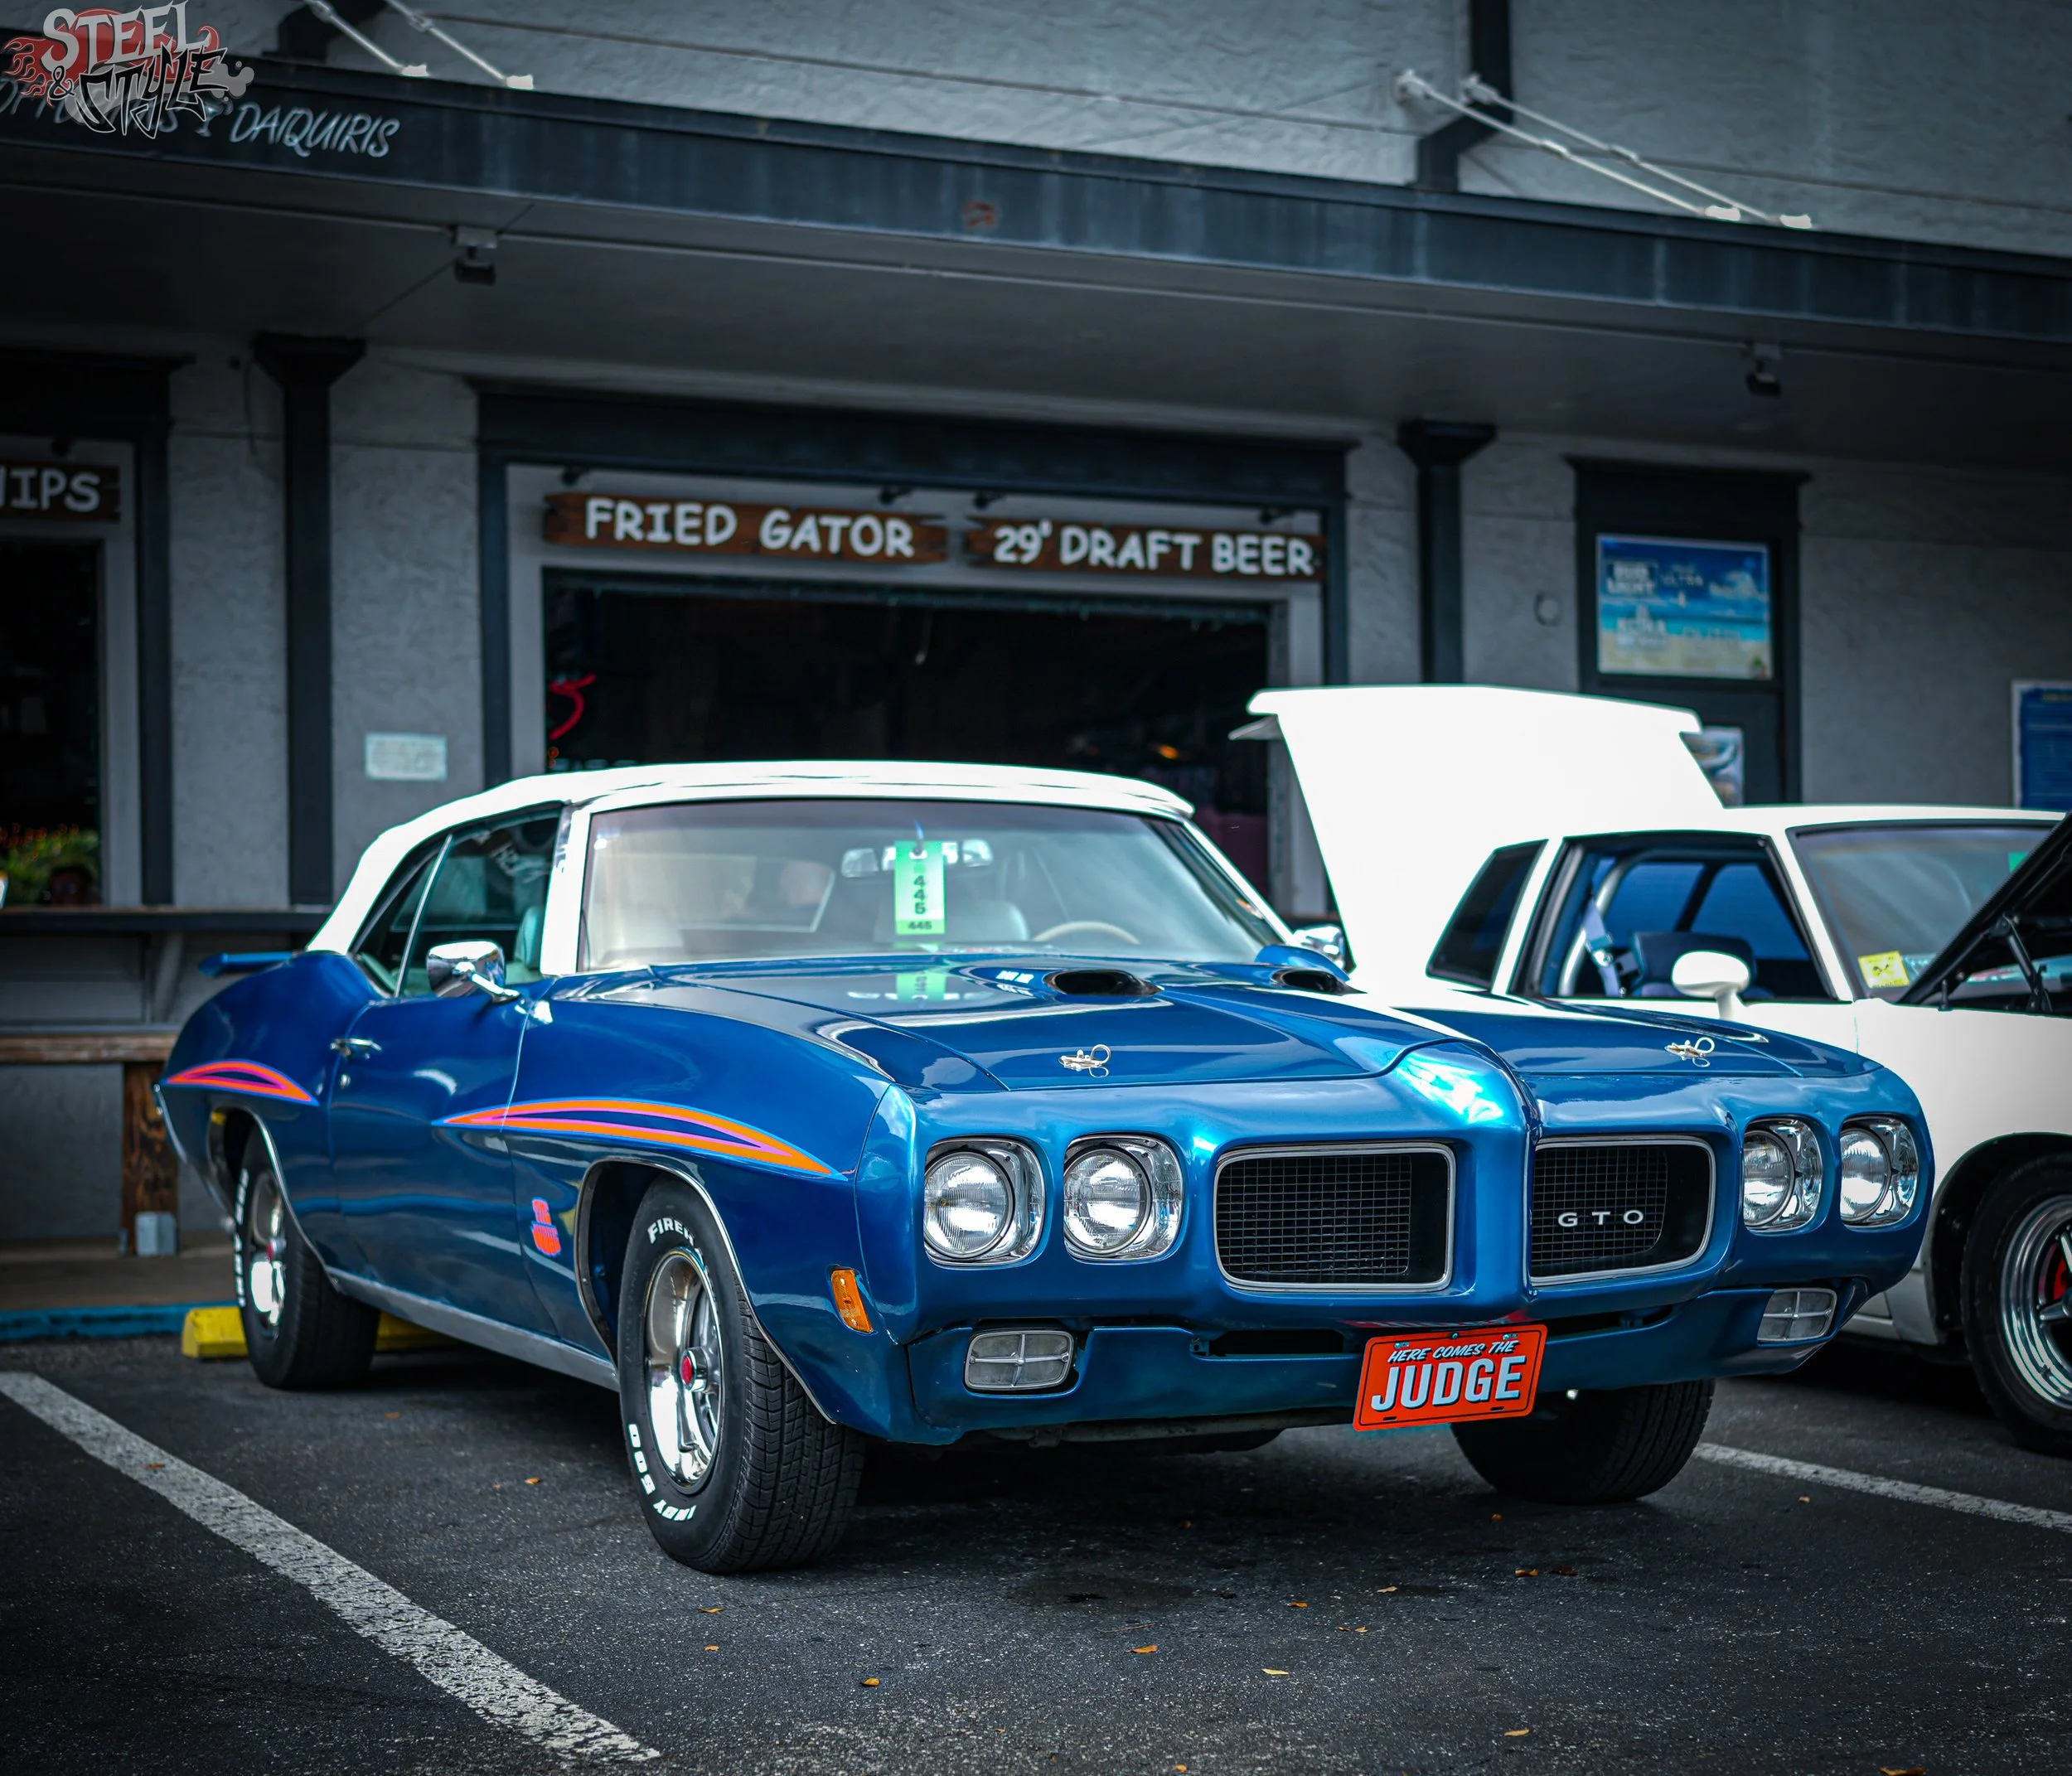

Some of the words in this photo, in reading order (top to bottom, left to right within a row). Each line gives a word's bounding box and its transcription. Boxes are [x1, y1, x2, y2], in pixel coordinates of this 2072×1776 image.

[230, 101, 401, 158] DAIQUIRIS
[0, 467, 100, 512] IPS
[585, 497, 738, 545] FRIED
[759, 508, 916, 558] GATOR
[1059, 525, 1203, 571] DRAFT
[1211, 534, 1315, 577] BEER
[1557, 1209, 1644, 1228] GTO
[1387, 1348, 1431, 1363] HERE
[1432, 1343, 1486, 1359] COMES
[1488, 1340, 1520, 1354] THE
[1371, 1354, 1527, 1411] JUDGE
